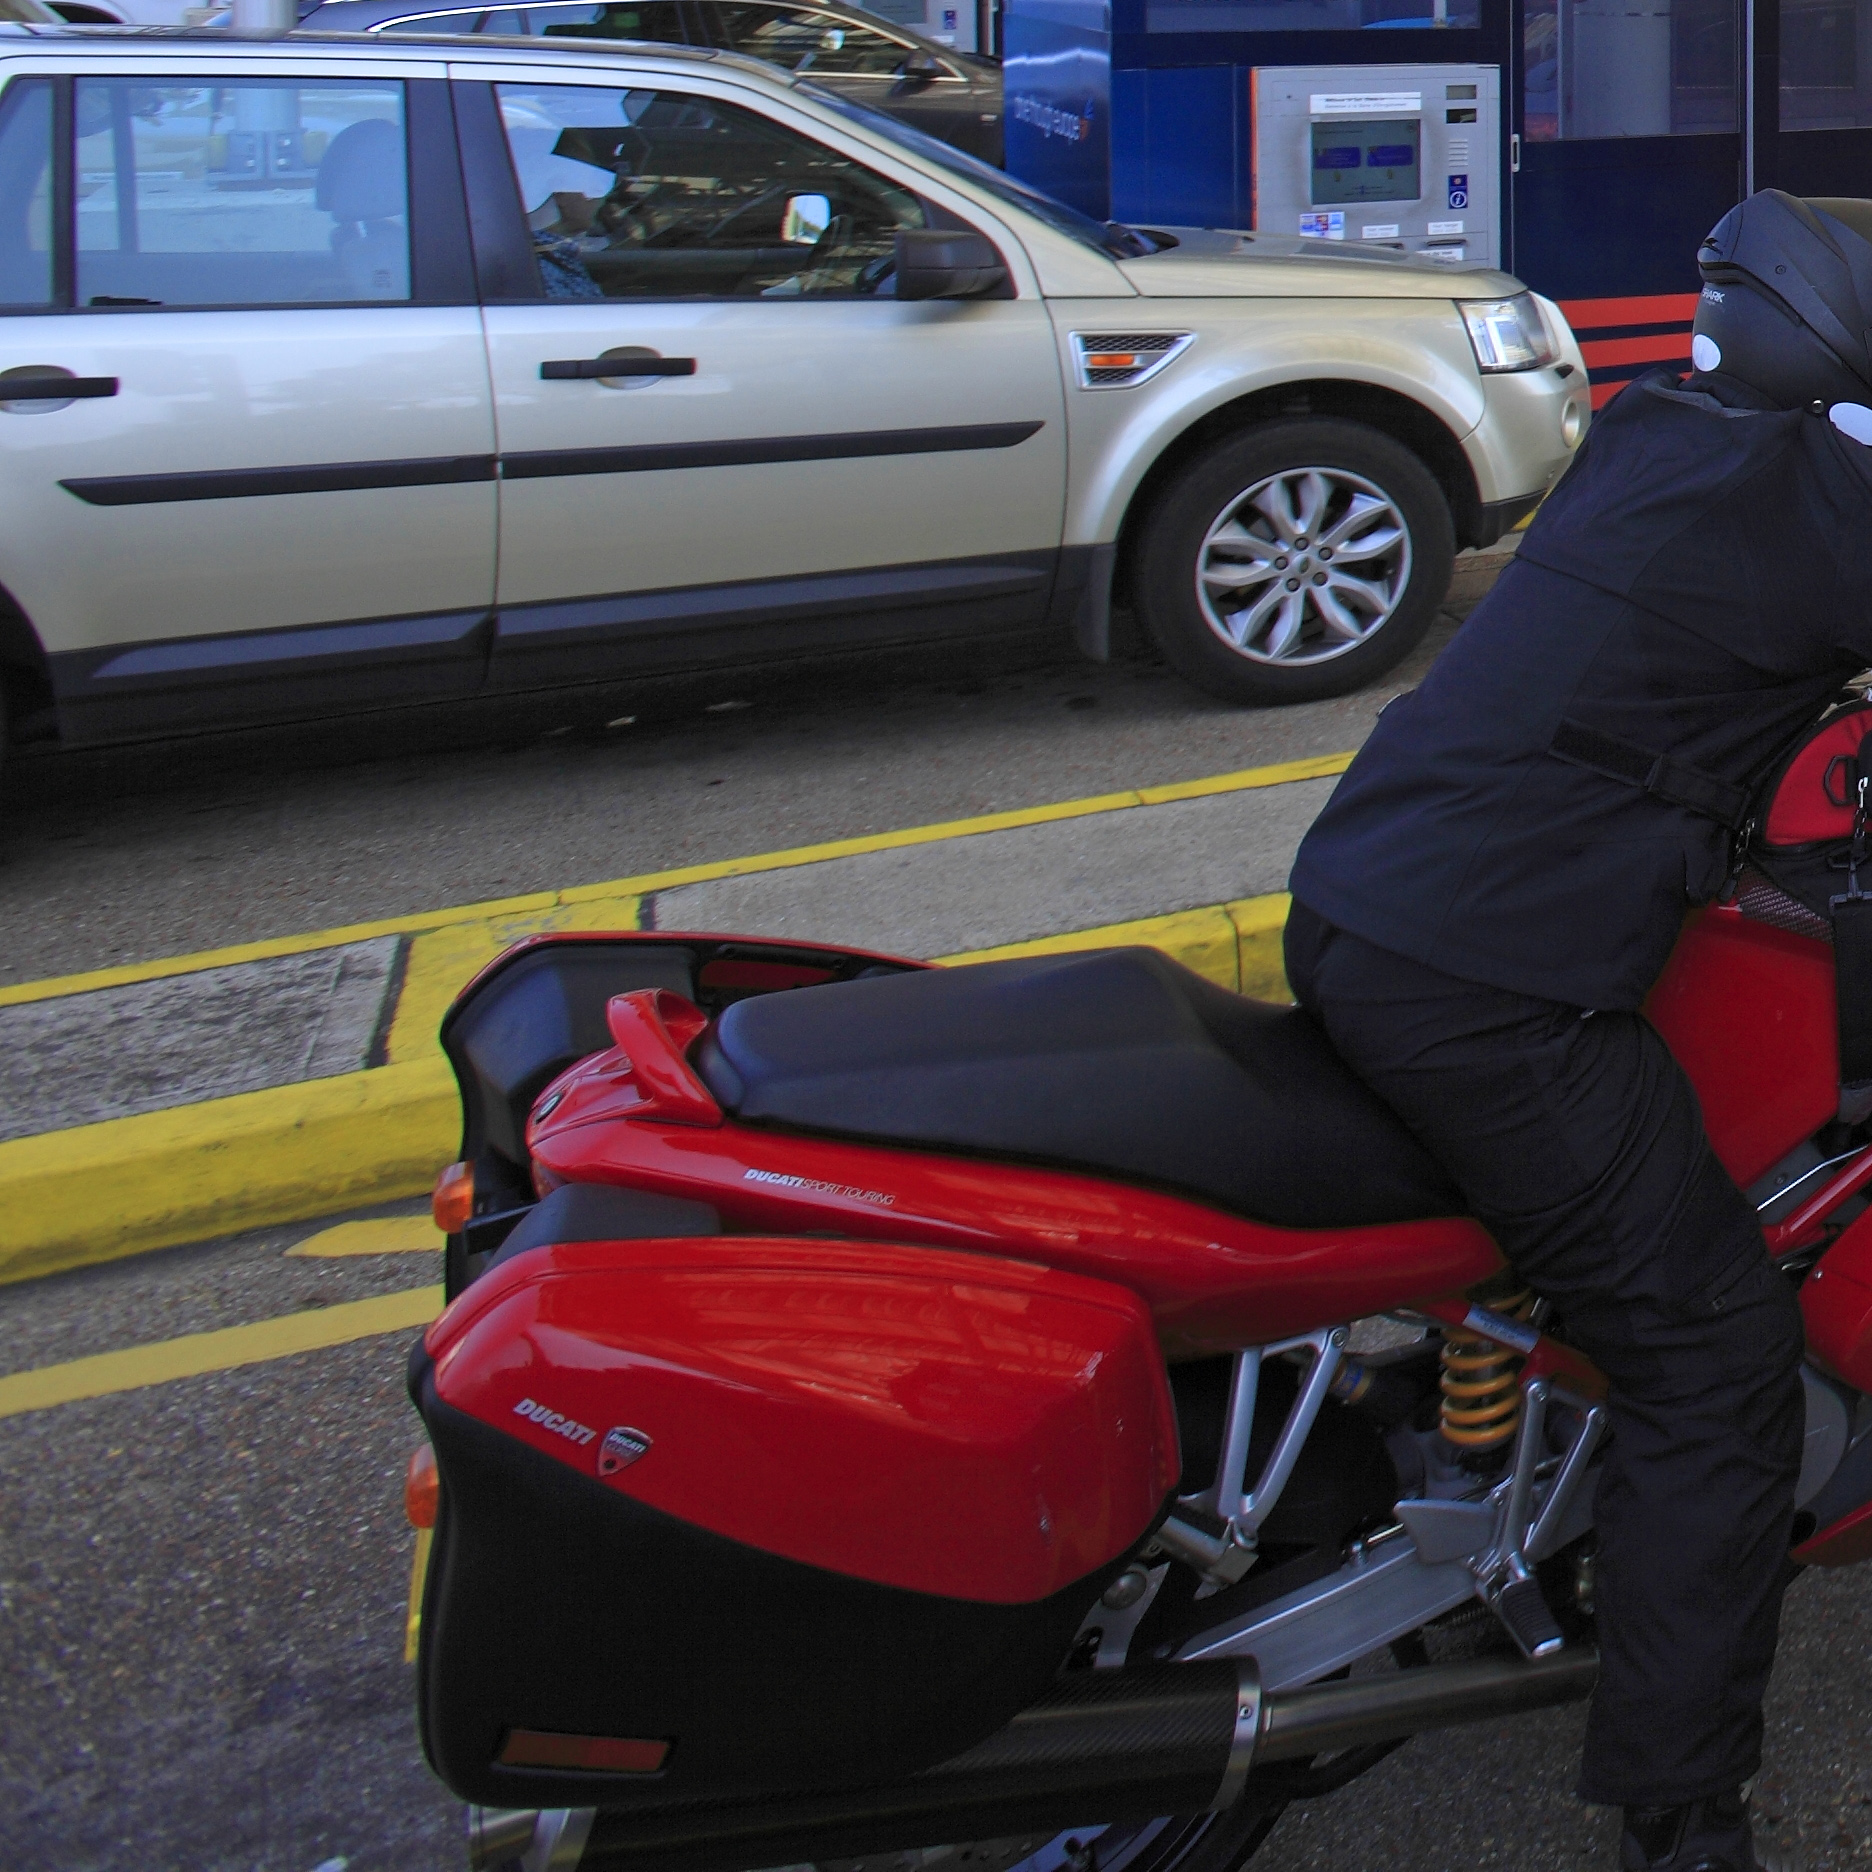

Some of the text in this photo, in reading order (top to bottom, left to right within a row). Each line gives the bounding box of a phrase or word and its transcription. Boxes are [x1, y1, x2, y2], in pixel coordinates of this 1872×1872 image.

[744, 1169, 896, 1205] DUCATI SPORT TOURING
[512, 1398, 597, 1446] DUCATI
[608, 1432, 647, 1453] DUCATI
